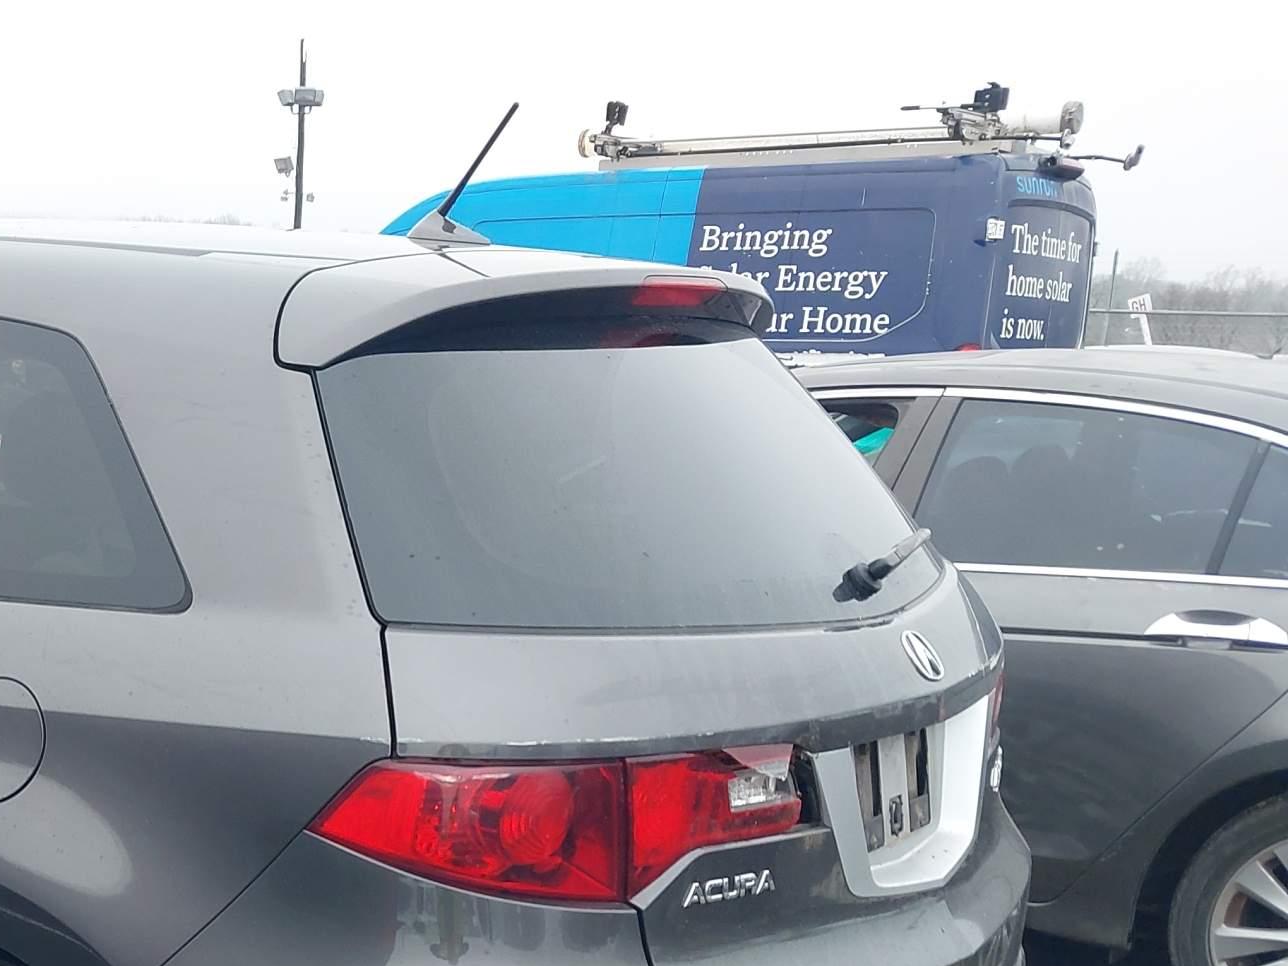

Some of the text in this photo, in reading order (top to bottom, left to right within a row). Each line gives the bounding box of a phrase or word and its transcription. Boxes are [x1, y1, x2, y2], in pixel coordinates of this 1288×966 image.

[699, 222, 833, 258] Bringing
[1011, 223, 1039, 256] The
[1041, 228, 1065, 260] time
[1066, 232, 1082, 263] for
[774, 264, 888, 299] Energy
[1005, 265, 1072, 302] home solar
[799, 306, 890, 334] Home
[999, 308, 1045, 341] is now.
[682, 869, 776, 908] ACURA
